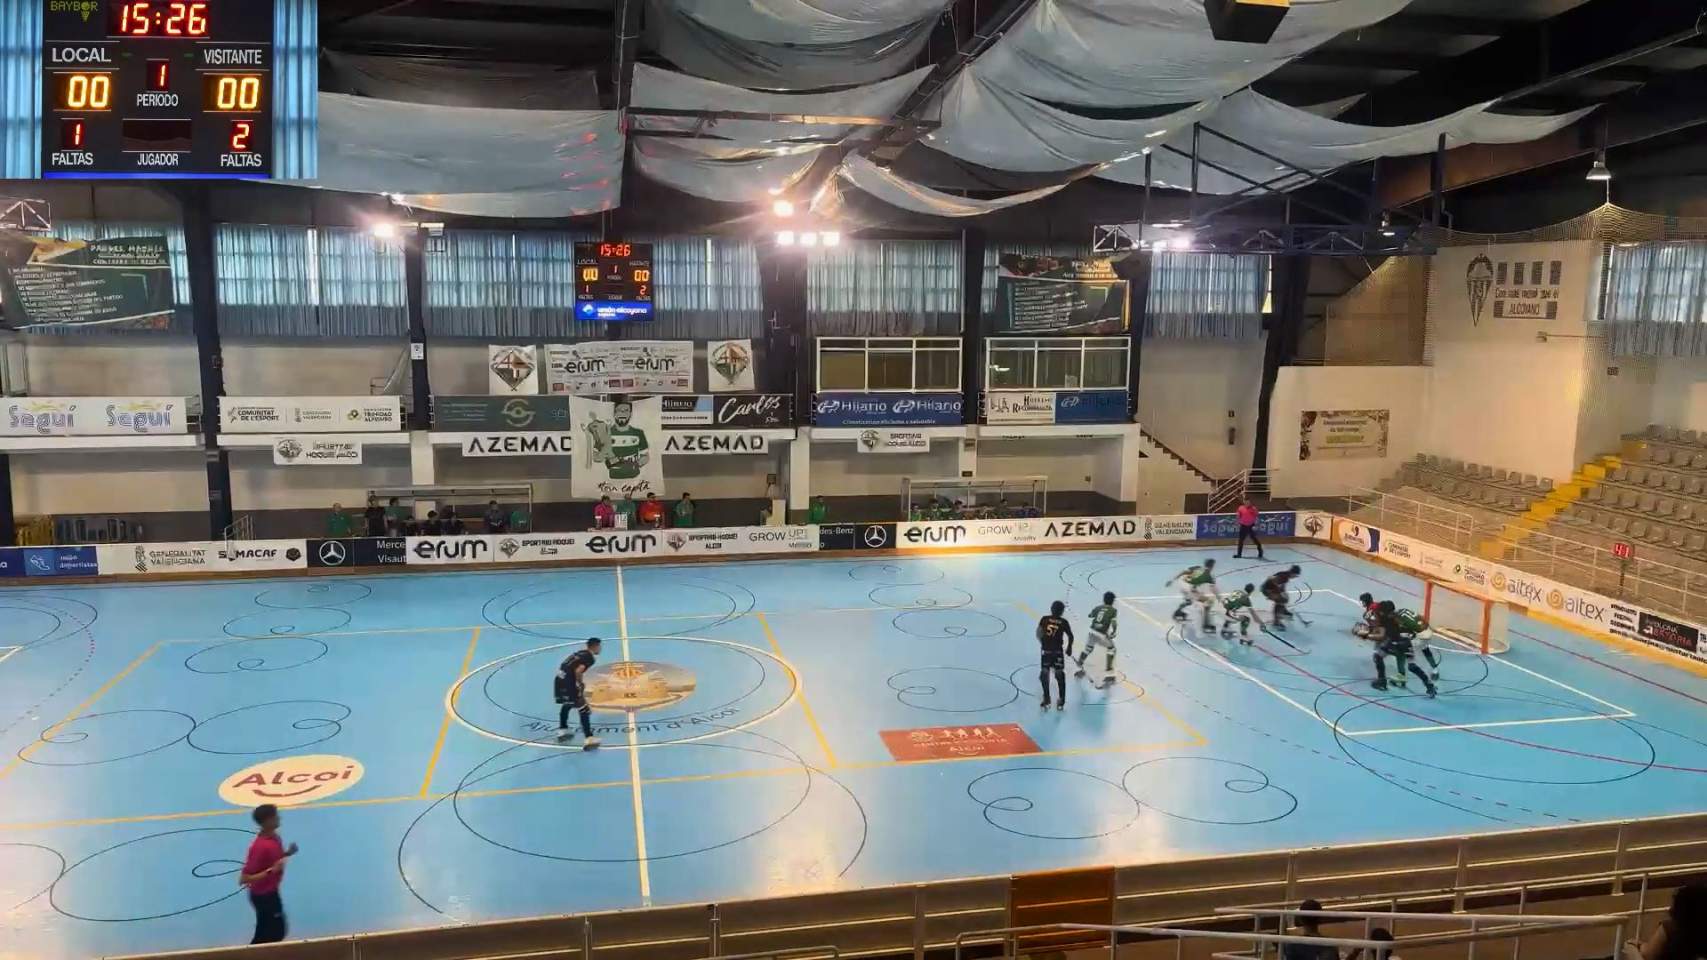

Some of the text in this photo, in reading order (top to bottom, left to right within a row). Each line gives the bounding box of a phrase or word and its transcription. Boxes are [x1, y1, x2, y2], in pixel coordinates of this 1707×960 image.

[634, 269, 650, 282] 00
[8, 404, 77, 434] Seguí
[105, 404, 173, 433] Seguí
[664, 435, 764, 451] AZEMAD
[749, 532, 786, 542] GROW
[904, 526, 966, 543] erum
[1044, 520, 1136, 538] AZEMAD
[377, 540, 406, 549] Merce
[413, 539, 488, 559] erum
[585, 533, 656, 553] erum
[218, 549, 277, 559] SMACAF
[1507, 578, 1542, 602] aitex
[1565, 597, 1606, 623] aitex
[232, 765, 355, 788] Alcoi
